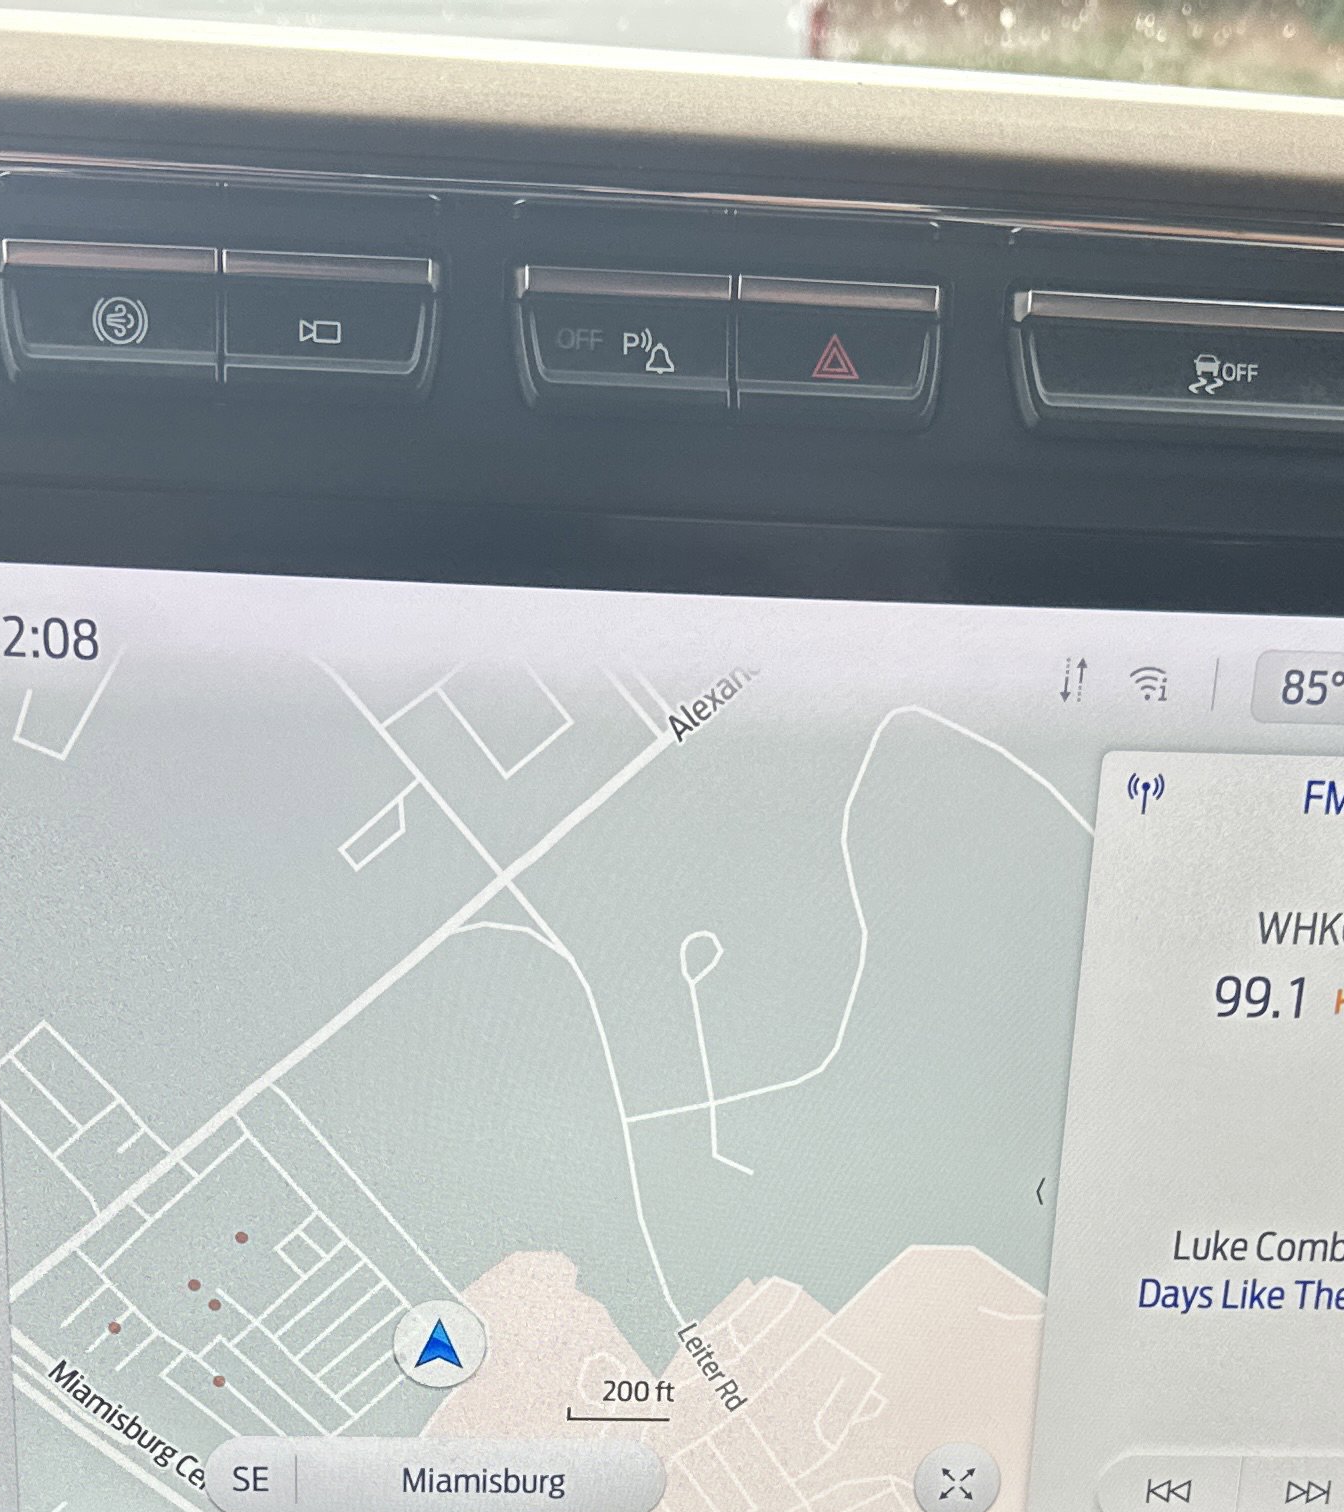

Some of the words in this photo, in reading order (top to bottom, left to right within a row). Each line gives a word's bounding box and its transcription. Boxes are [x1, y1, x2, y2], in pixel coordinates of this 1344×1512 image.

[1221, 362, 1259, 385] OFF
[1215, 975, 1306, 1019] 99.1
[1173, 1229, 1248, 1261] Luke
[1138, 1278, 1214, 1315] Days
[1221, 1278, 1285, 1310] Like
[678, 1322, 725, 1381] Leiter
[715, 1379, 748, 1412] Rd
[602, 1380, 650, 1402] 200
[654, 1380, 676, 1403] ft
[48, 1359, 178, 1468] Miamisburg
[232, 1465, 269, 1492] SE
[402, 1467, 566, 1500] Miamisburg
